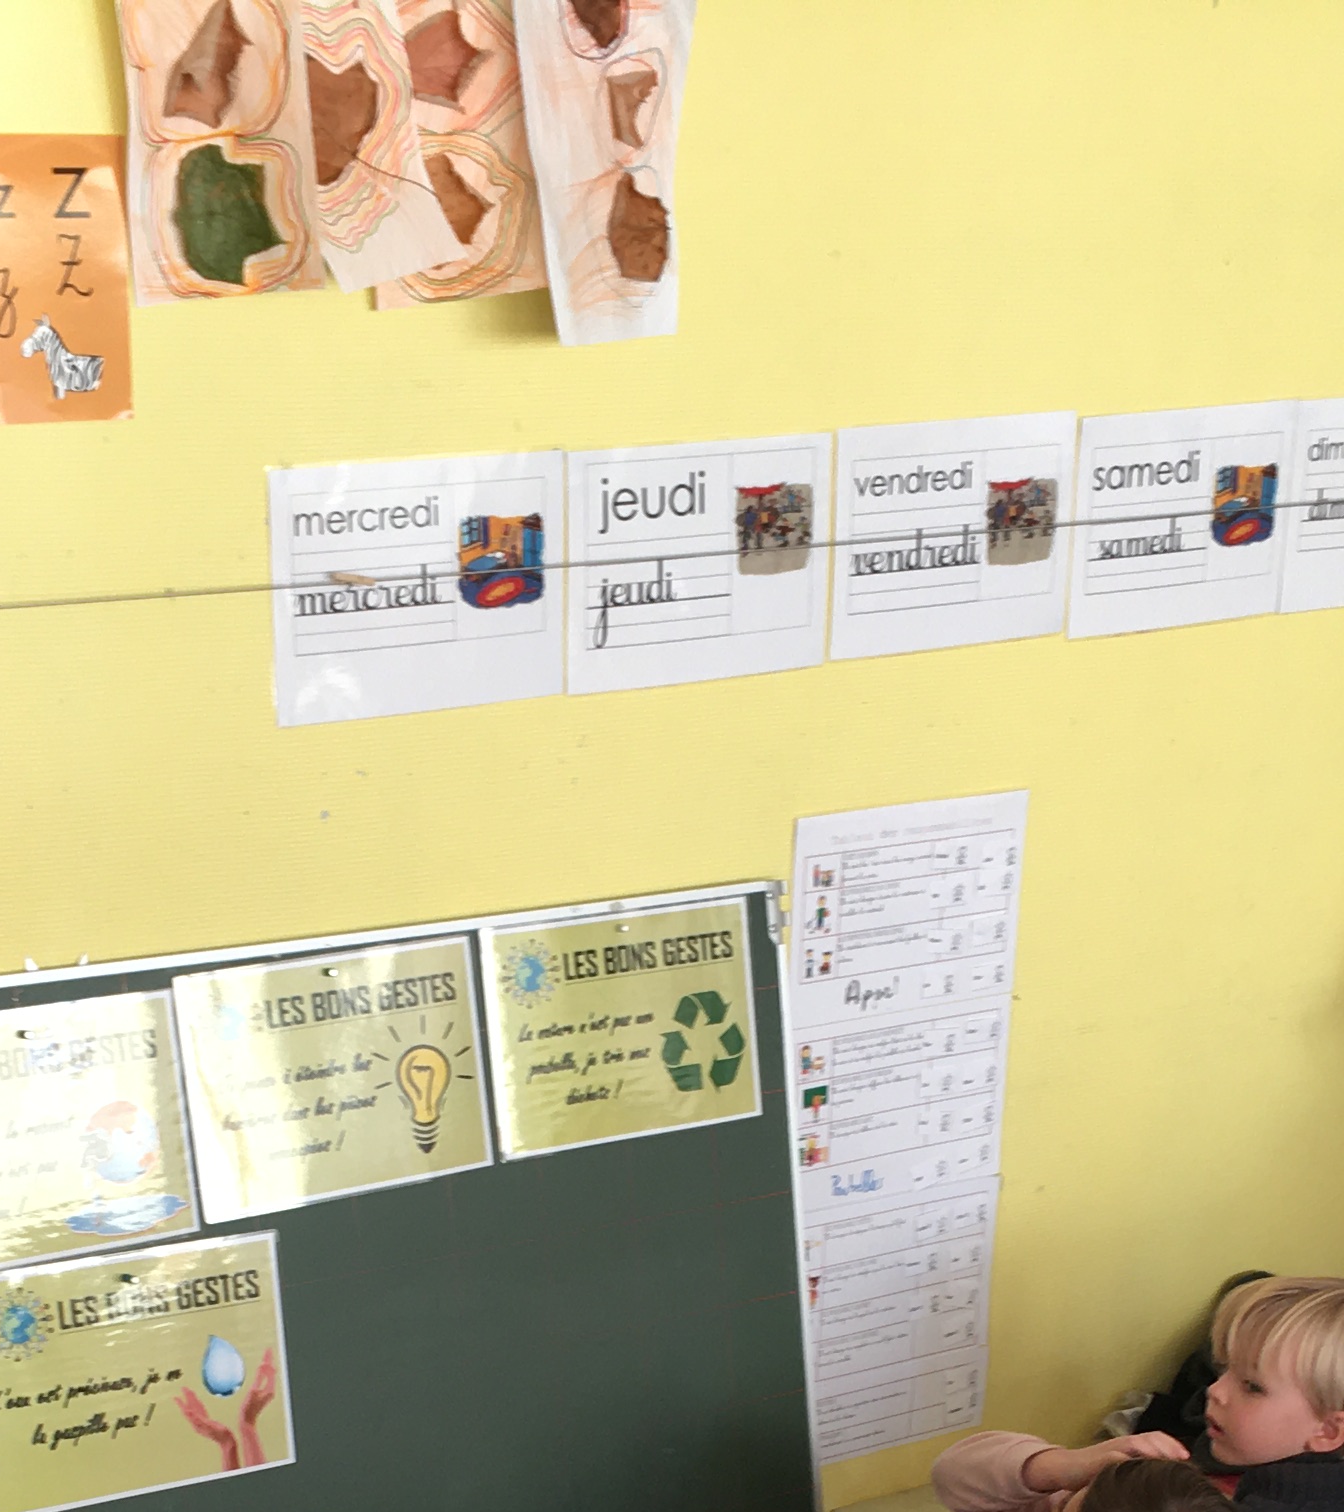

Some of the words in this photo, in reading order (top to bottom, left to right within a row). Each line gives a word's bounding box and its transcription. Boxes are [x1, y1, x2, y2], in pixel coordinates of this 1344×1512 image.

[50, 167, 91, 219] Z
[56, 234, 94, 297] Z
[853, 462, 974, 497] vendredi
[1092, 450, 1202, 492] samedi
[293, 496, 440, 536] mercredi
[598, 471, 707, 534] jeudi
[848, 523, 980, 576] vendredi
[1097, 517, 1183, 559] samedi
[294, 563, 441, 617] mercredi
[591, 558, 678, 650] jeudi
[562, 948, 600, 981] LES
[603, 941, 658, 975] BONS
[662, 930, 734, 967] GESTES
[264, 997, 306, 1029] LES
[312, 984, 371, 1022] BONS
[376, 971, 457, 1012] GESTES
[58, 1295, 99, 1330] LES
[177, 1269, 260, 1310] GESTES
